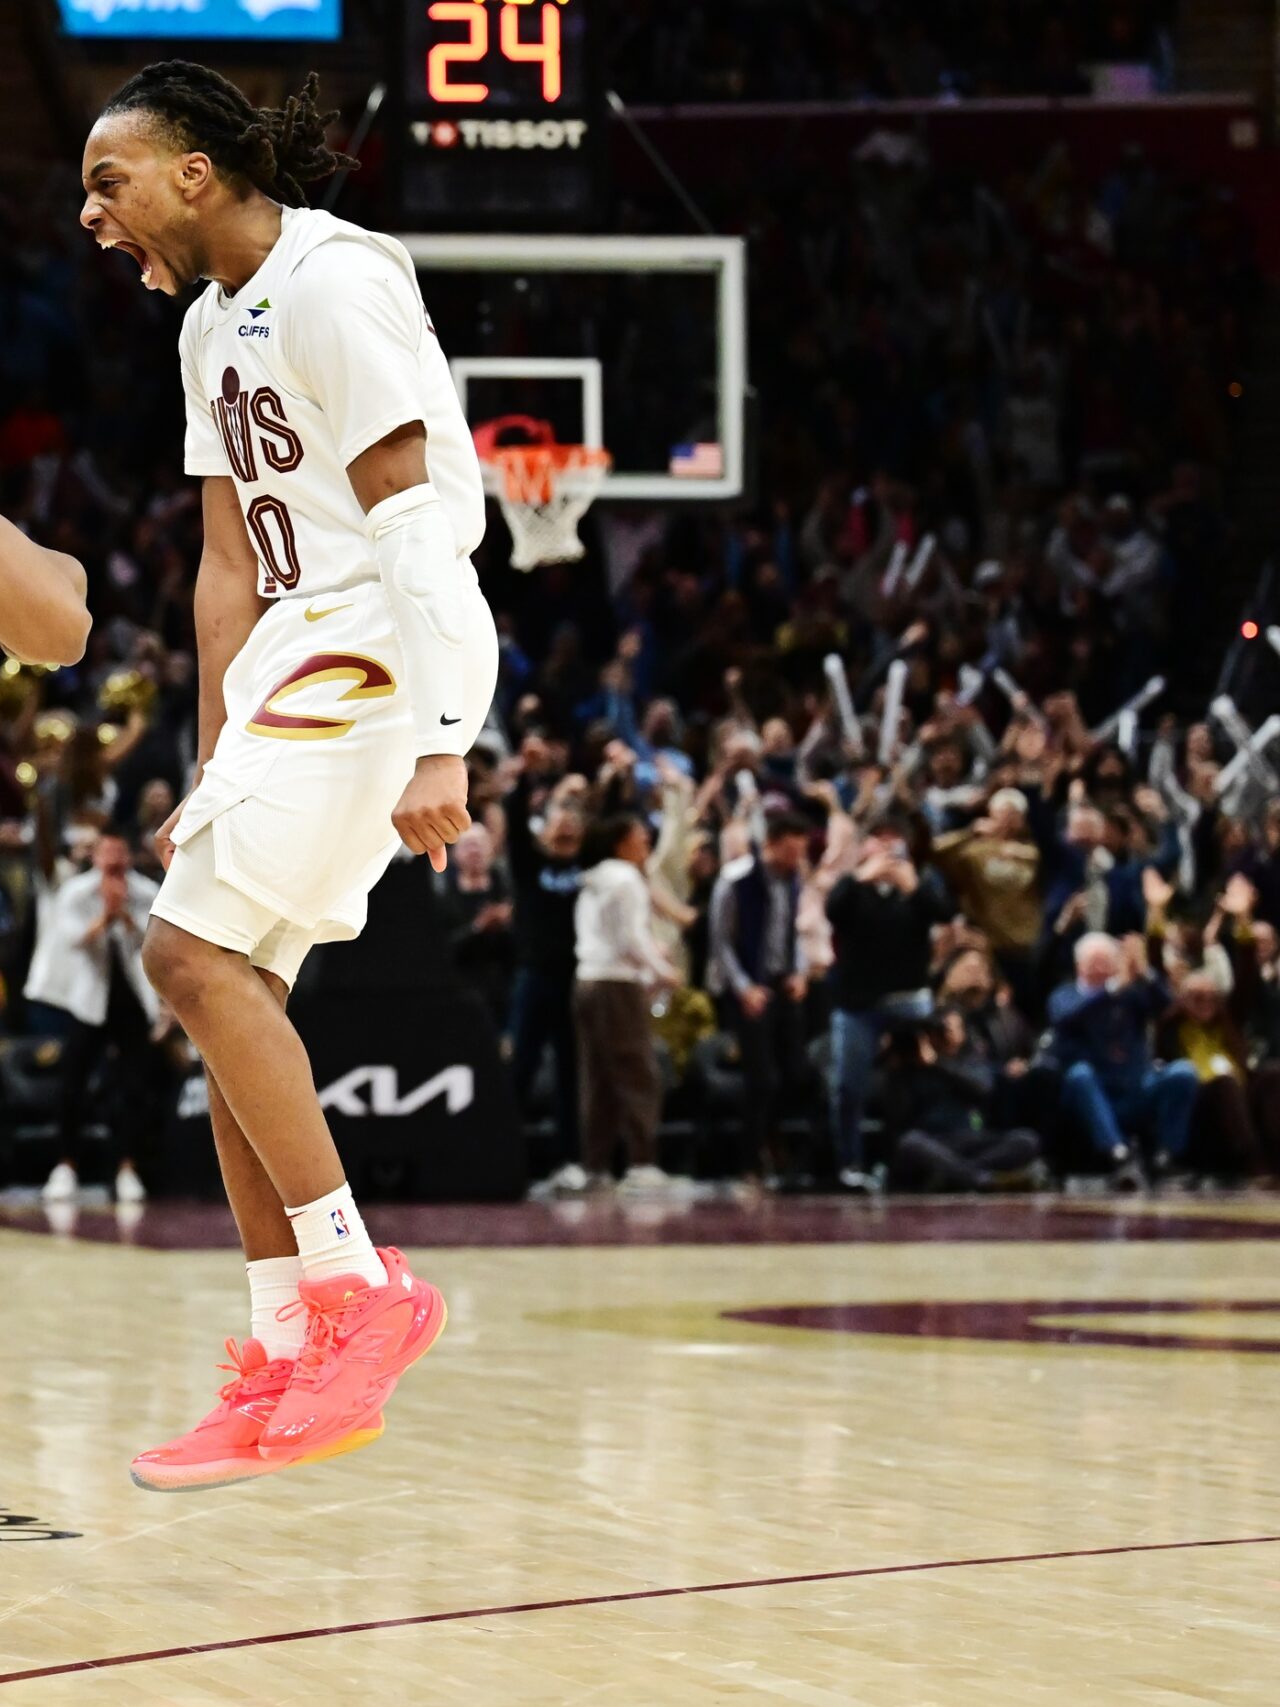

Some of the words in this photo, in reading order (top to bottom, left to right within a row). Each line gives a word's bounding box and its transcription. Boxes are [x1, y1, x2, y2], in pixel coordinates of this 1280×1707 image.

[427, 1, 561, 103] 24
[459, 119, 587, 149] TISSOT
[238, 325, 270, 338] CLIFFS
